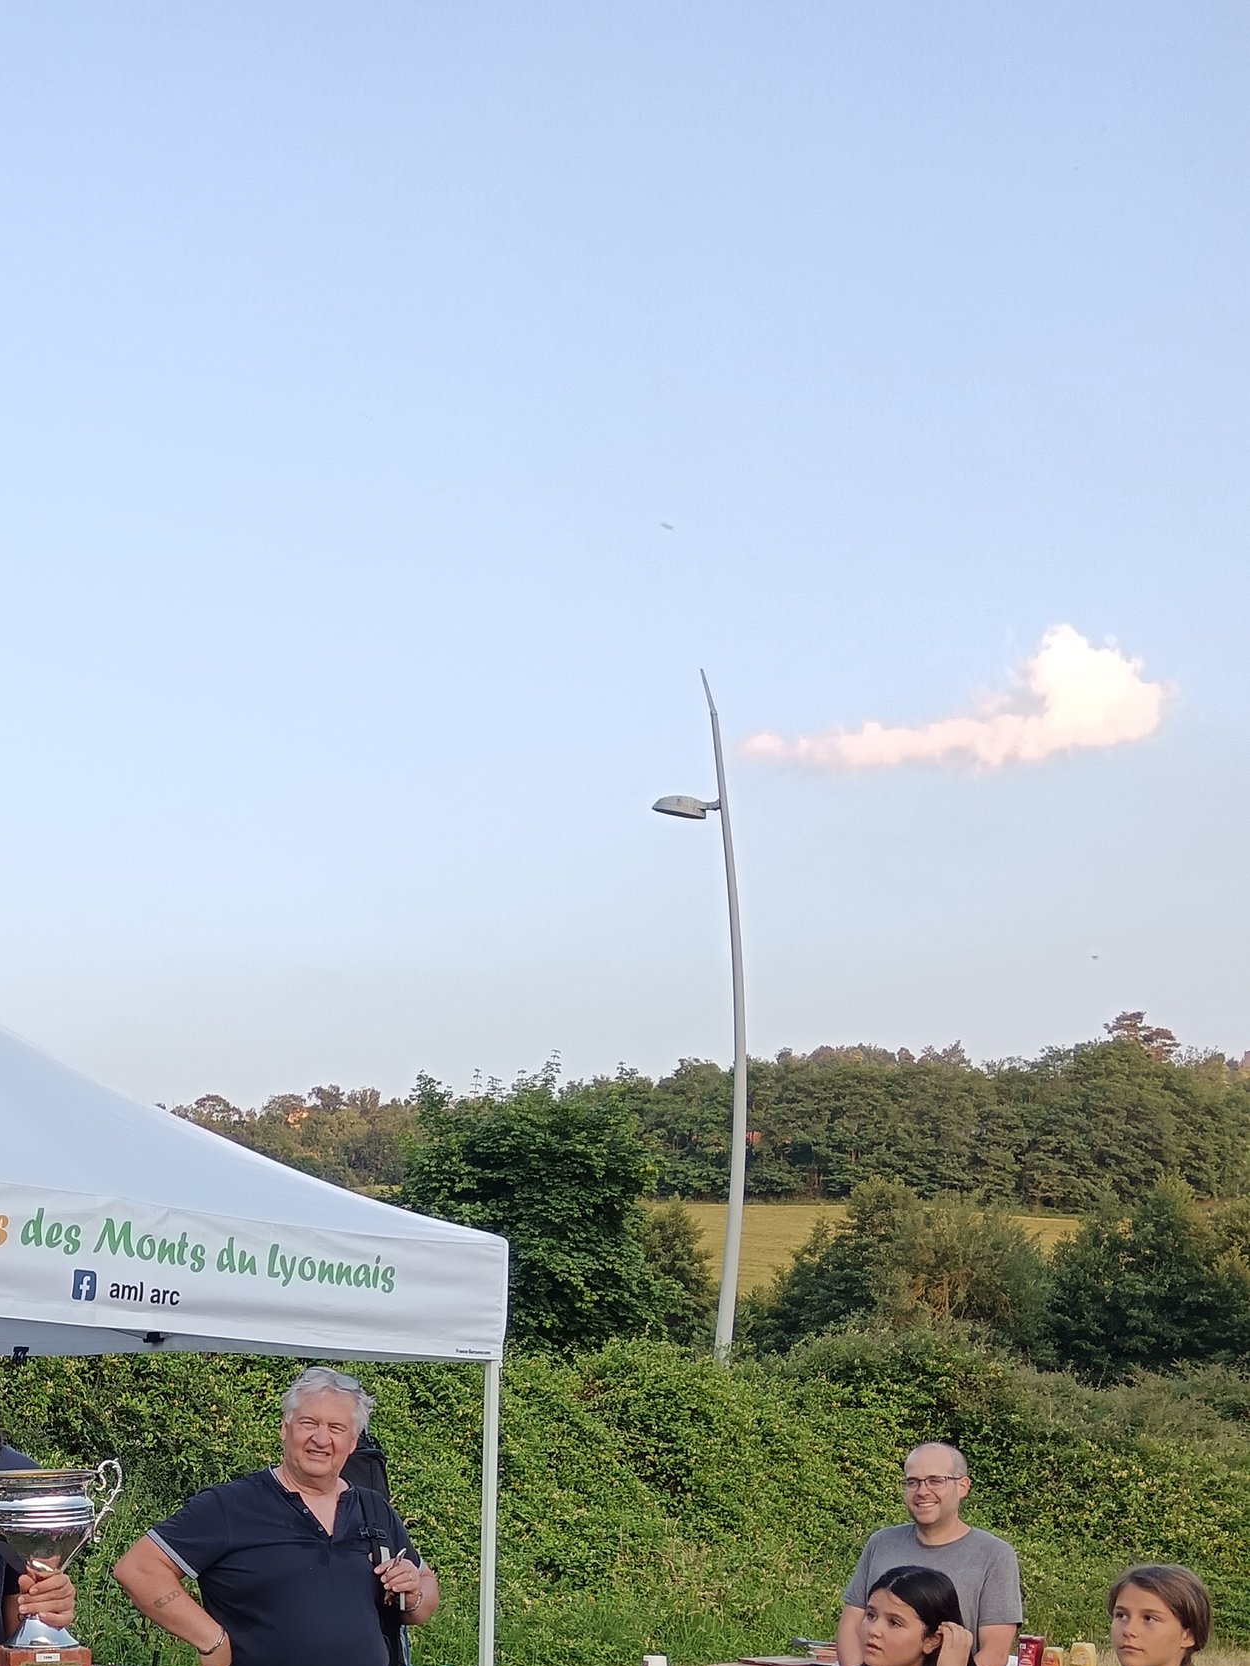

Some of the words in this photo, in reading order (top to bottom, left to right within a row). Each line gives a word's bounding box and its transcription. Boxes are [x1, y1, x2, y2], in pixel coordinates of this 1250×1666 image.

[20, 1207, 81, 1256] des
[93, 1217, 206, 1273] Monts
[216, 1236, 257, 1275] du
[267, 1243, 396, 1294] Lyonnais
[109, 1281, 144, 1302] aml
[149, 1288, 181, 1306] arc
